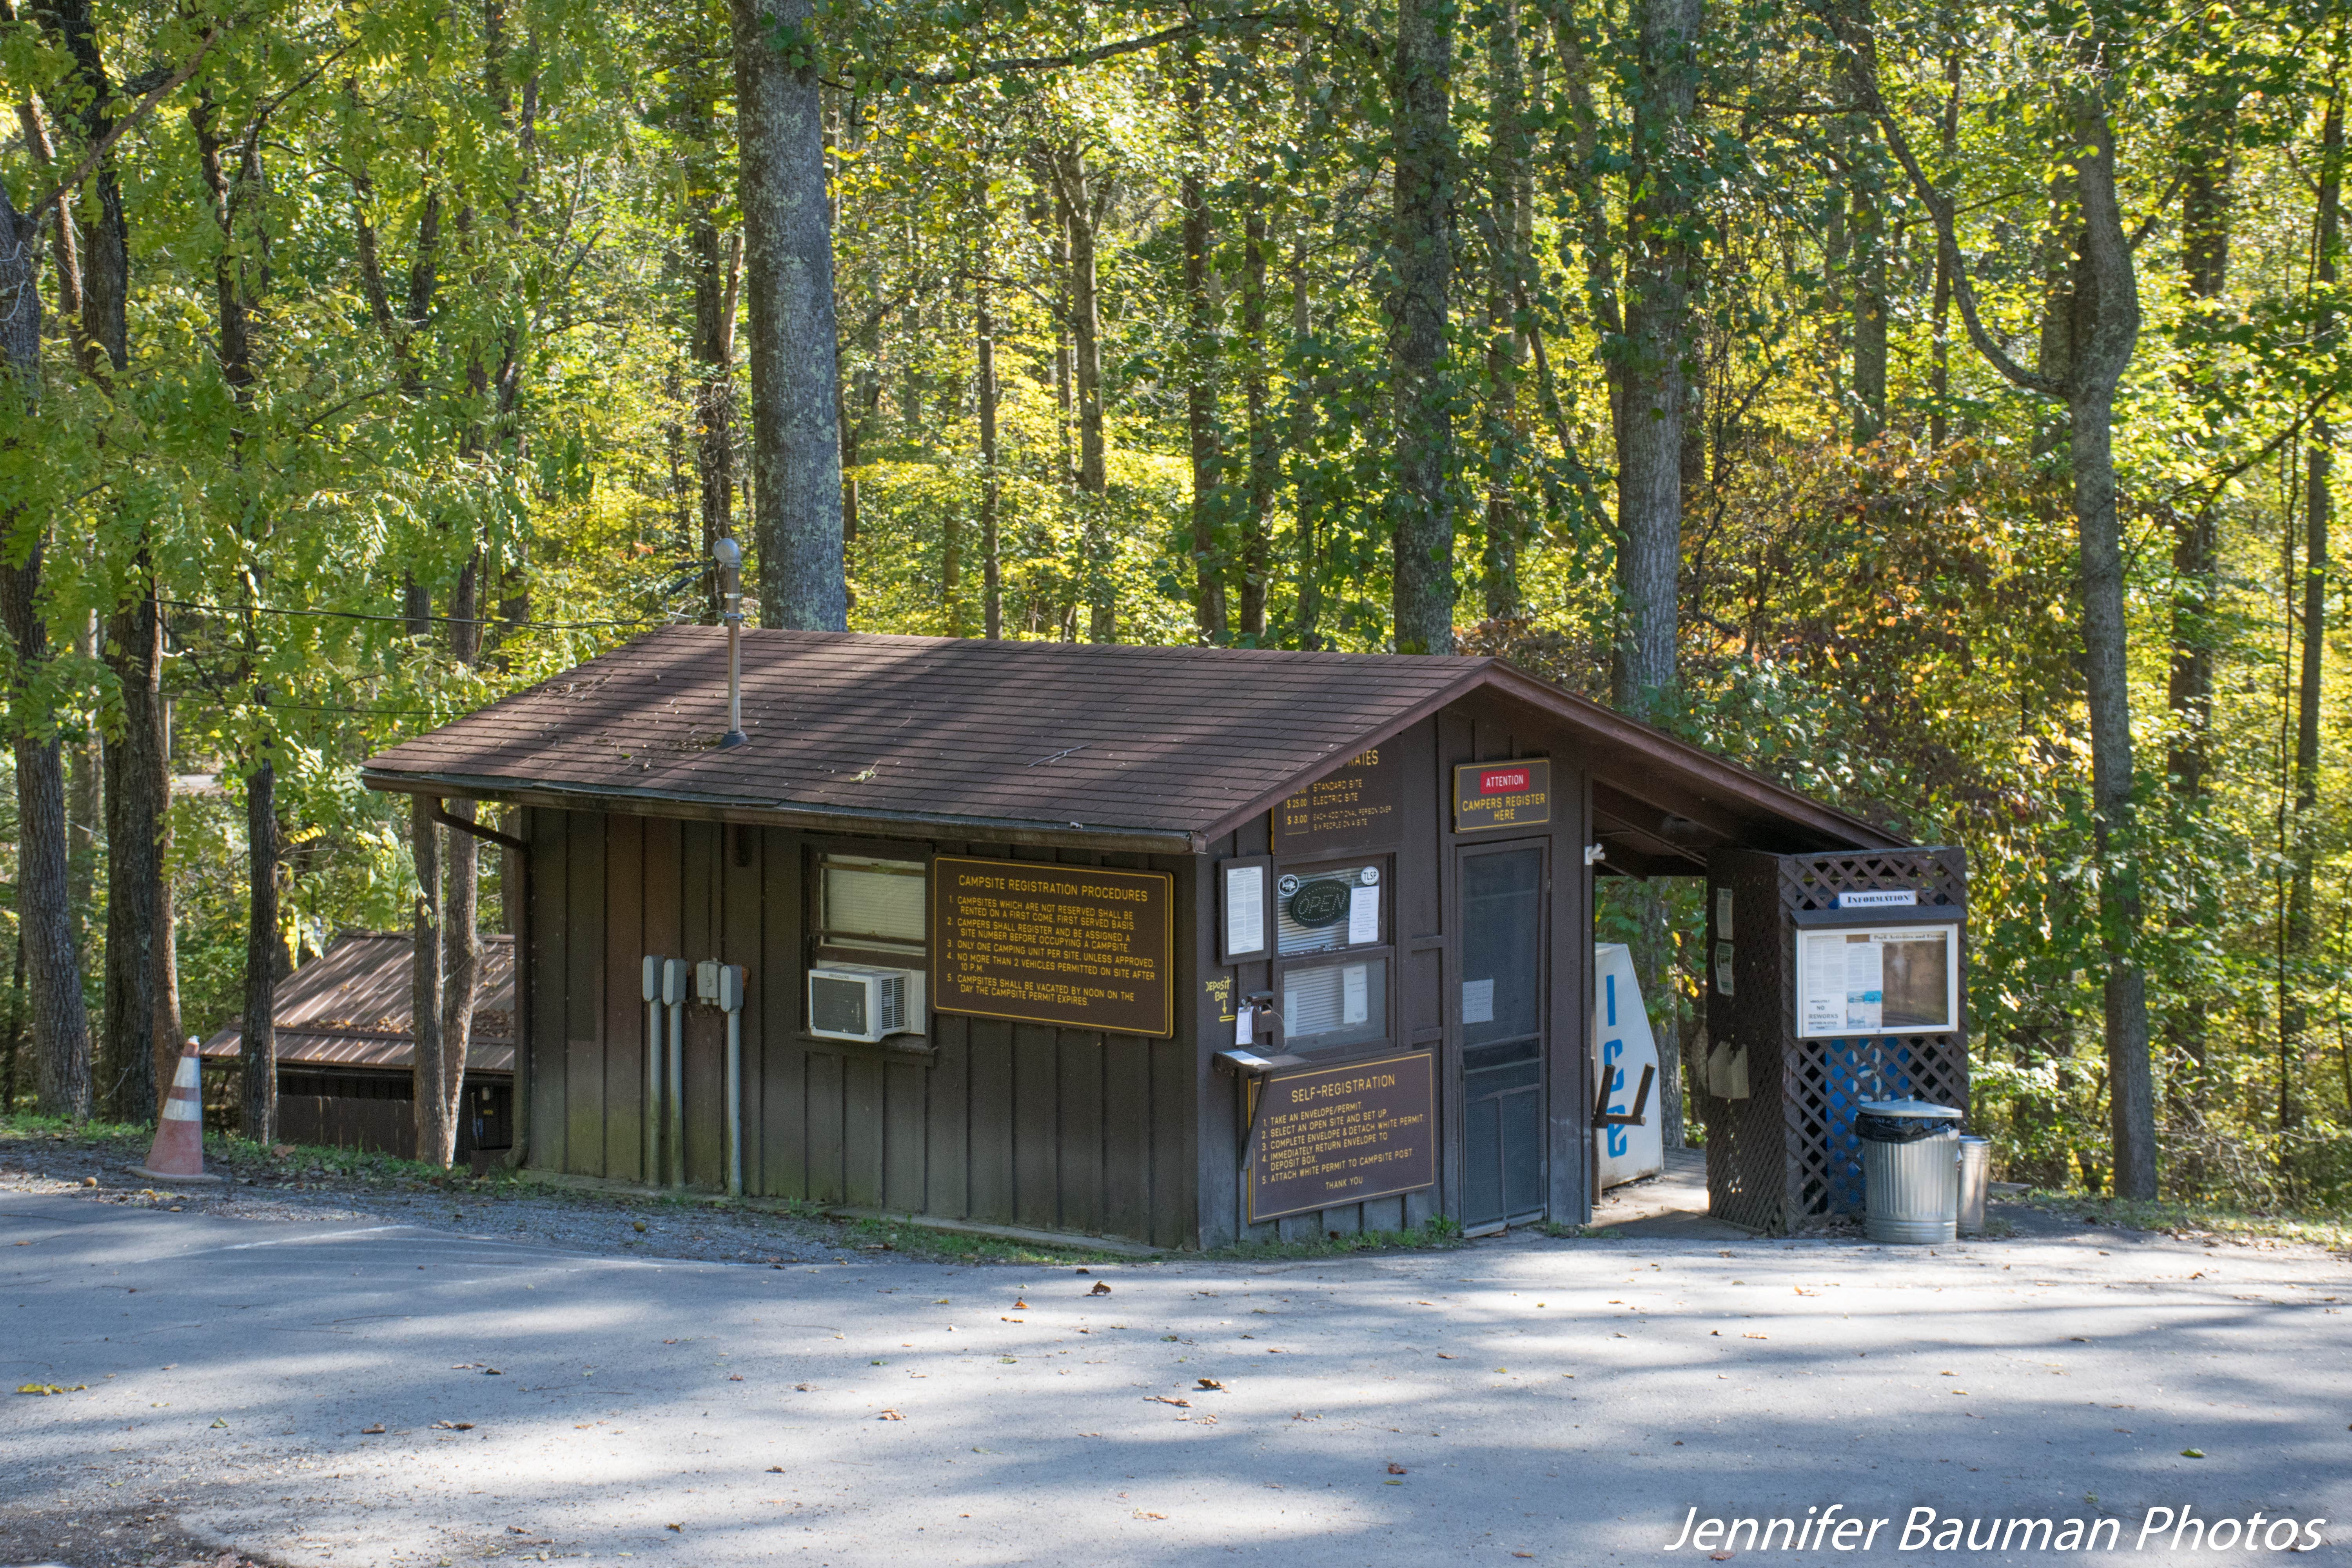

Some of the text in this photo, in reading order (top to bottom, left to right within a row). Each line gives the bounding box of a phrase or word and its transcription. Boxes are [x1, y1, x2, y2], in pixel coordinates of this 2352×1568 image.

[1313, 781, 1346, 792] STANDARD
[1349, 779, 1362, 788] SITE
[1486, 775, 1524, 788] ATTENTION
[1287, 799, 1307, 808] $ 25.00
[1313, 792, 1358, 805] ELECTRIC SITE
[1463, 793, 1545, 811] CAMPERS REGISTER
[1287, 815, 1307, 825] $ 3.00
[1494, 808, 1514, 820] HERE
[1363, 871, 1376, 880] TLSP
[959, 875, 1147, 902] CAMPSITE REGISTRATION PROCEDURES
[958, 896, 997, 907] CAMPSITES
[1000, 900, 1022, 909] WHICH
[1025, 902, 1038, 911] ARE
[1041, 904, 1055, 913] NOT
[1058, 905, 1095, 917] RESERVED
[1098, 908, 1121, 919] SHALL
[1123, 911, 1132, 920] BE
[1298, 894, 1345, 915] OPEN
[1847, 895, 1909, 903] INFORMATION
[960, 906, 987, 916] RENTED
[989, 908, 1000, 917] ON
[1009, 910, 1030, 920] FIRST
[1057, 915, 1078, 924] FIRST
[1080, 916, 1109, 928] SERVED
[958, 918, 990, 929] CAMPERS
[993, 921, 1015, 932] SHALL
[1018, 923, 1052, 935] REGISTER
[1055, 927, 1070, 937] AND
[1073, 928, 1082, 938] BE
[1085, 930, 1122, 942] ASSIGNED
[961, 928, 975, 937] SITE
[978, 930, 1007, 940] NUMBER
[1009, 933, 1036, 943] BEFORE
[1039, 935, 1081, 947] OCCUPYING
[957, 940, 974, 949] ONLY
[977, 942, 990, 951] ONE
[994, 943, 1025, 955] CAMPING
[1047, 948, 1060, 958] PER
[1083, 953, 1112, 964] UNLESS
[957, 953, 967, 962] NO
[970, 954, 989, 964] MORE
[993, 956, 1011, 965] THAN
[1014, 958, 1019, 967] 2
[1022, 959, 1055, 970] VEHICLES
[1057, 962, 1098, 975] PERMITTED
[1100, 967, 1111, 975] ON
[1113, 968, 1129, 978] SITE
[1132, 970, 1154, 980] AFTER
[958, 975, 997, 987] CAMPSITES
[1000, 979, 1022, 990] SHALL
[1024, 981, 1033, 991] BE
[1036, 984, 1069, 994] VACATED
[1071, 986, 1080, 995] BY
[1083, 988, 1104, 997] NOON
[1107, 990, 1118, 998] ON
[1121, 991, 1134, 1001] THE
[976, 986, 988, 995] THE
[991, 987, 1026, 999] CAMPSITE
[1029, 991, 1054, 1001] PERMIT
[1292, 1074, 1395, 1103] SELF-REGISTRATION
[1270, 1114, 1286, 1124] TAKE
[1270, 1125, 1295, 1138] SELECT
[1298, 1123, 1307, 1132] AN
[1309, 1120, 1327, 1131] OPEN
[1329, 1116, 1344, 1127] SITE
[1347, 1114, 1360, 1123] AND
[1363, 1111, 1375, 1121] SET
[1270, 1135, 1305, 1149] COMPLETE
[1307, 1129, 1340, 1143] ENVELOPE
[1343, 1128, 1347, 1136] &
[1348, 1123, 1375, 1135] DETACH
[1378, 1119, 1397, 1129] WHITE
[1271, 1145, 1312, 1160] IMMEDIATELY
[1315, 1141, 1341, 1152] RETURN
[1343, 1134, 1376, 1147] ENVELOPE
[1270, 1157, 1299, 1171] DEPOSIT
[1271, 1171, 1297, 1182] ATTACH
[1299, 1165, 1319, 1177] WHITE
[1321, 1160, 1345, 1172] PERMIT
[1348, 1158, 1357, 1167] TO
[1359, 1152, 1392, 1165] CAMPSITE
[1326, 1179, 1347, 1189] THANK
